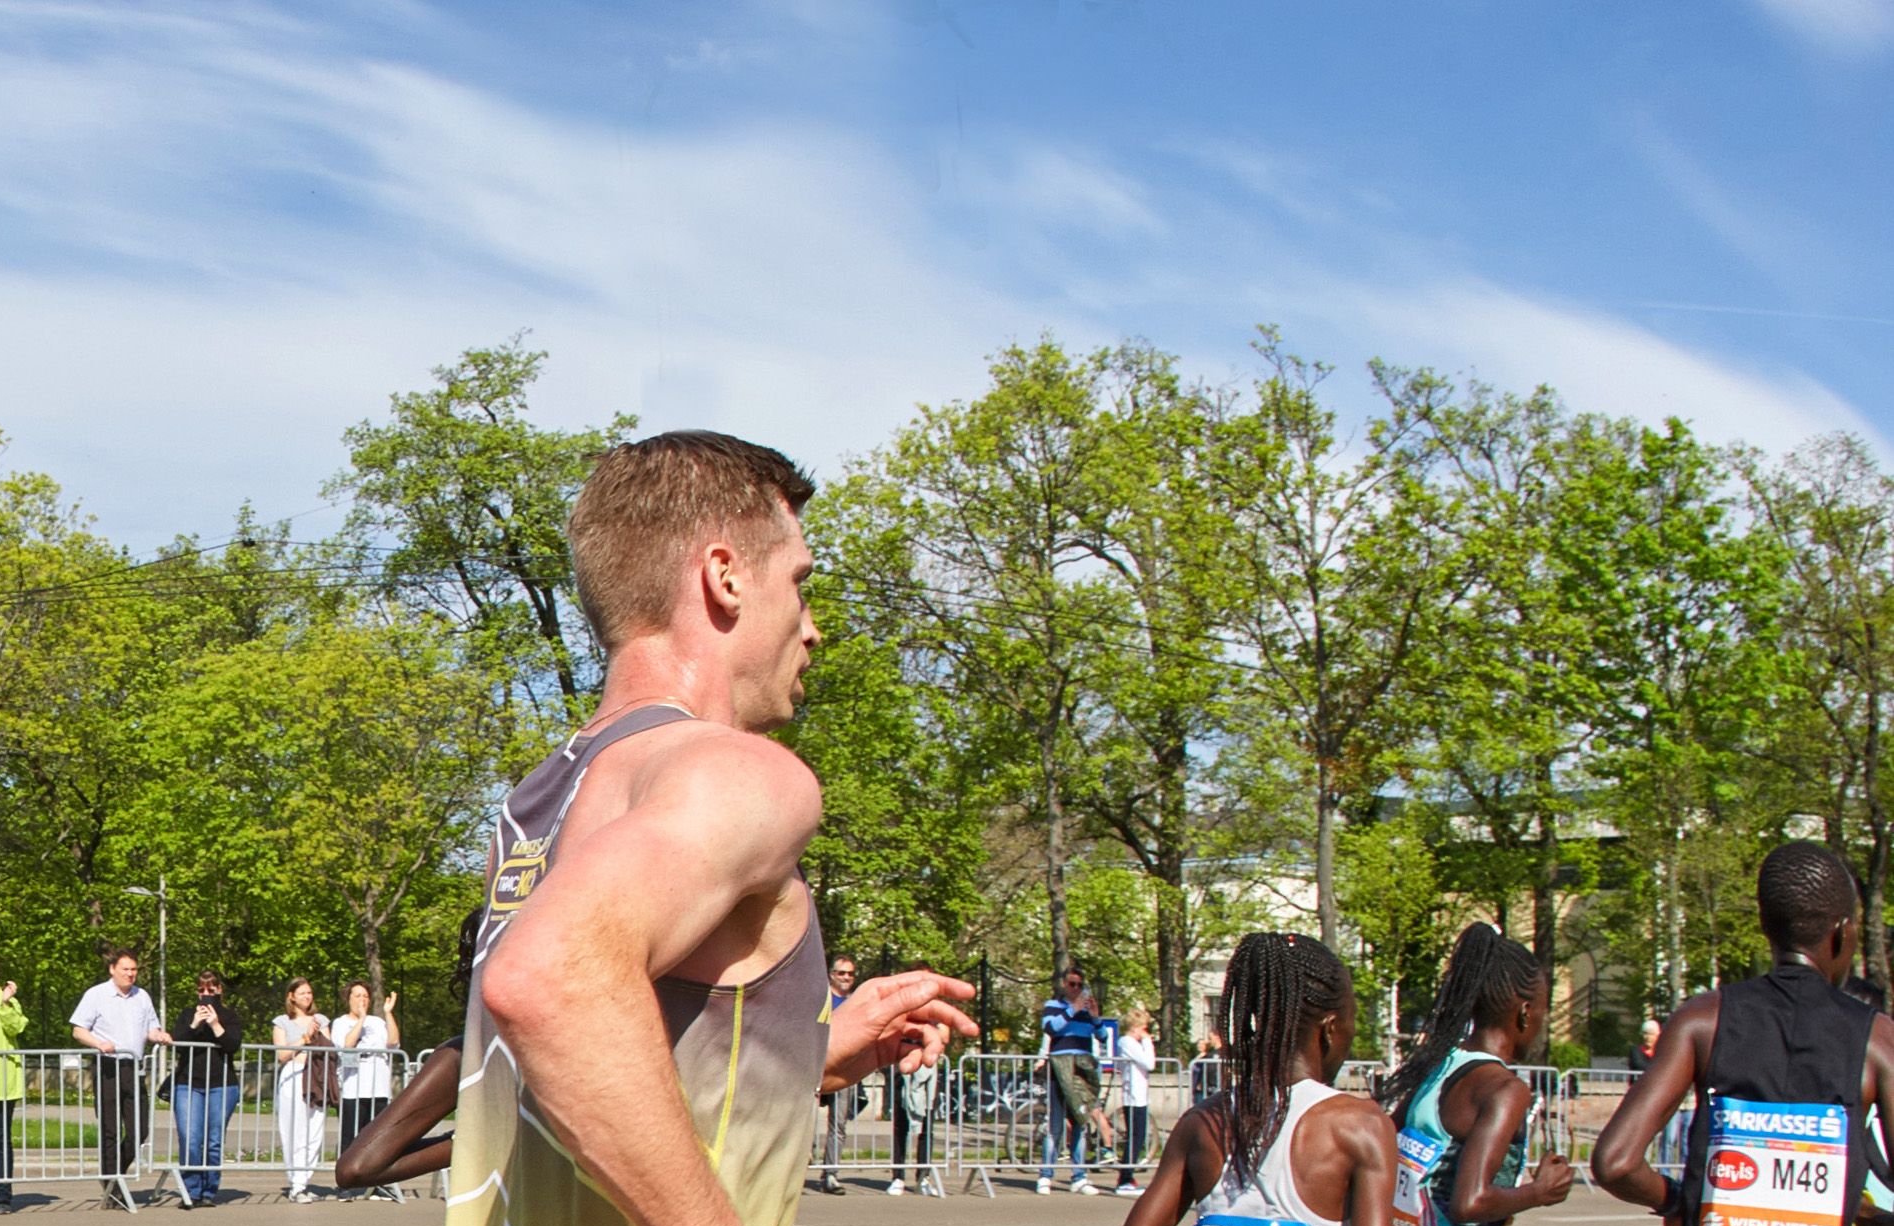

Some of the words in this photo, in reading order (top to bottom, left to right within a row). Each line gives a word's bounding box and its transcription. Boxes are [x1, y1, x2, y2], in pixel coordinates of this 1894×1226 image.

[1713, 1111, 1819, 1136] SPARKASSE
[1710, 1159, 1755, 1183] Hervis
[1772, 1158, 1829, 1194] M48
